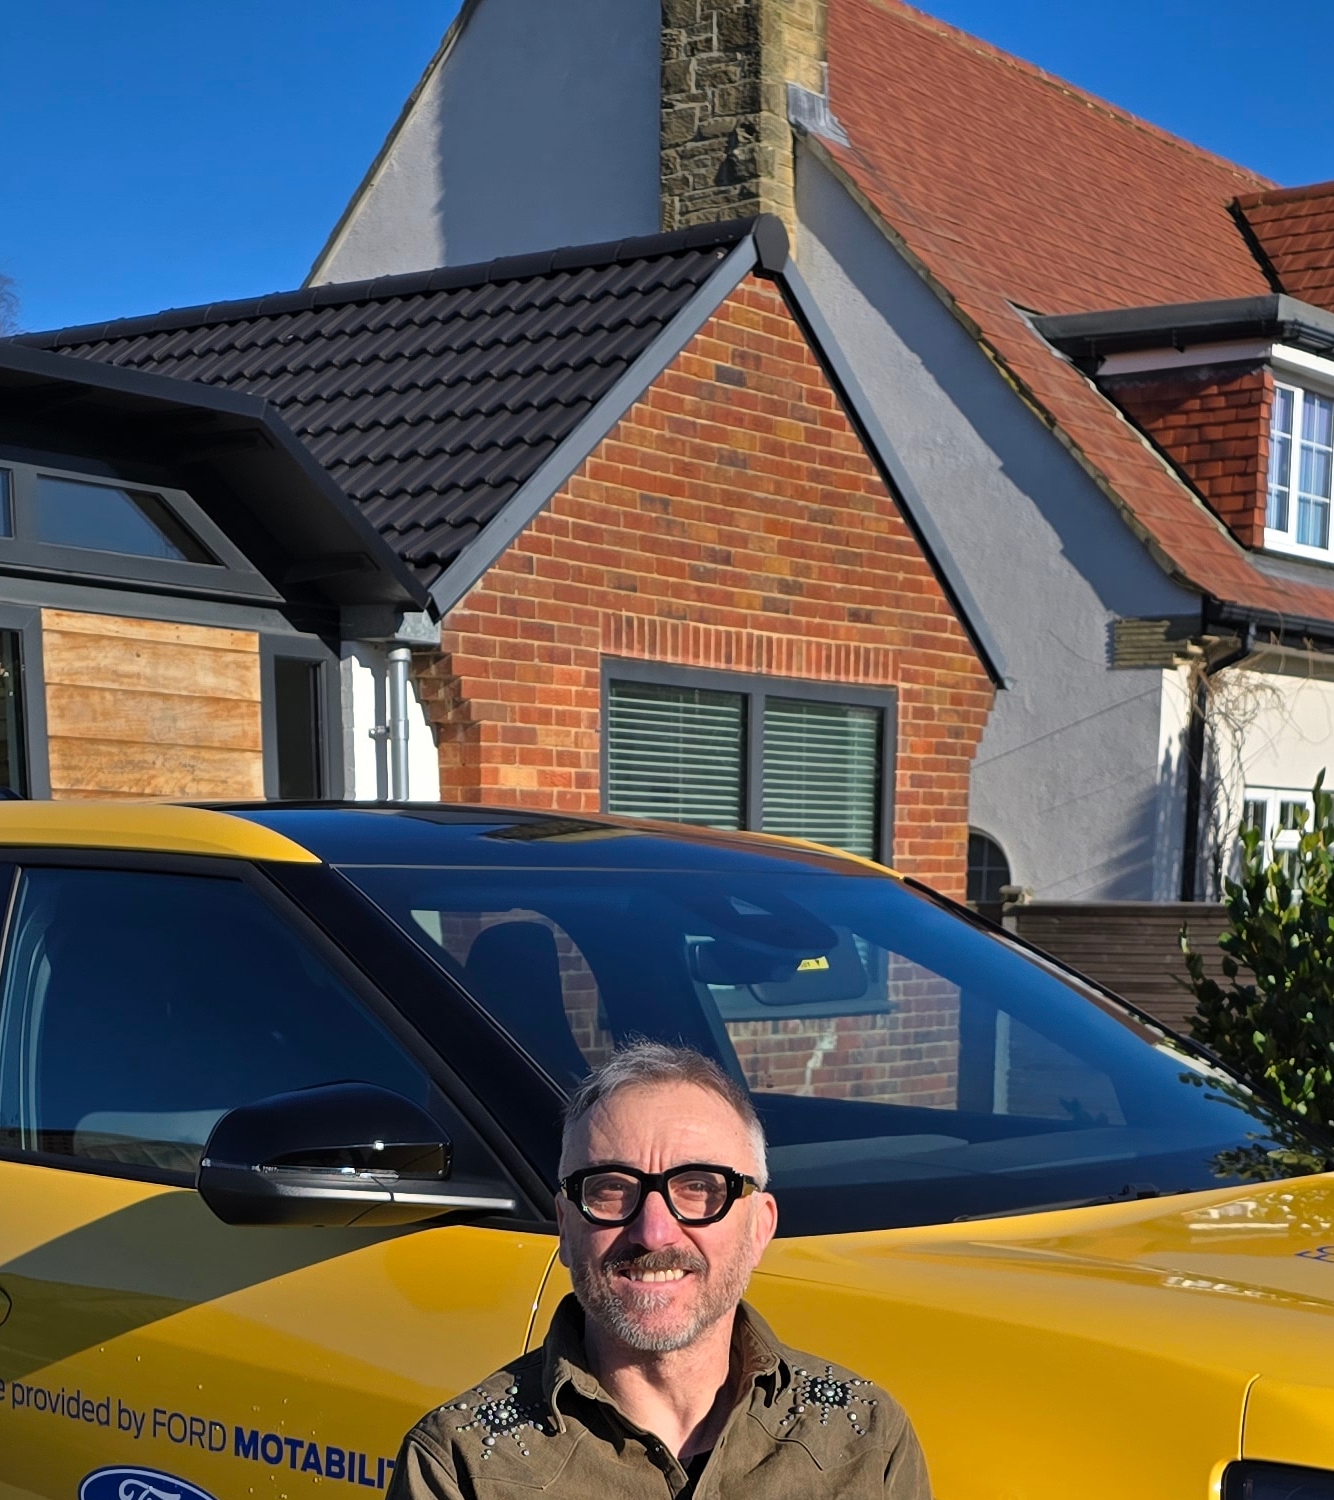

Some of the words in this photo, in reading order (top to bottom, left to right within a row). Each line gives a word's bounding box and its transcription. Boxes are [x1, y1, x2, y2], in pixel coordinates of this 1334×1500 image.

[11, 1381, 110, 1427] provided
[117, 1399, 146, 1440] by
[152, 1408, 227, 1452] FORD
